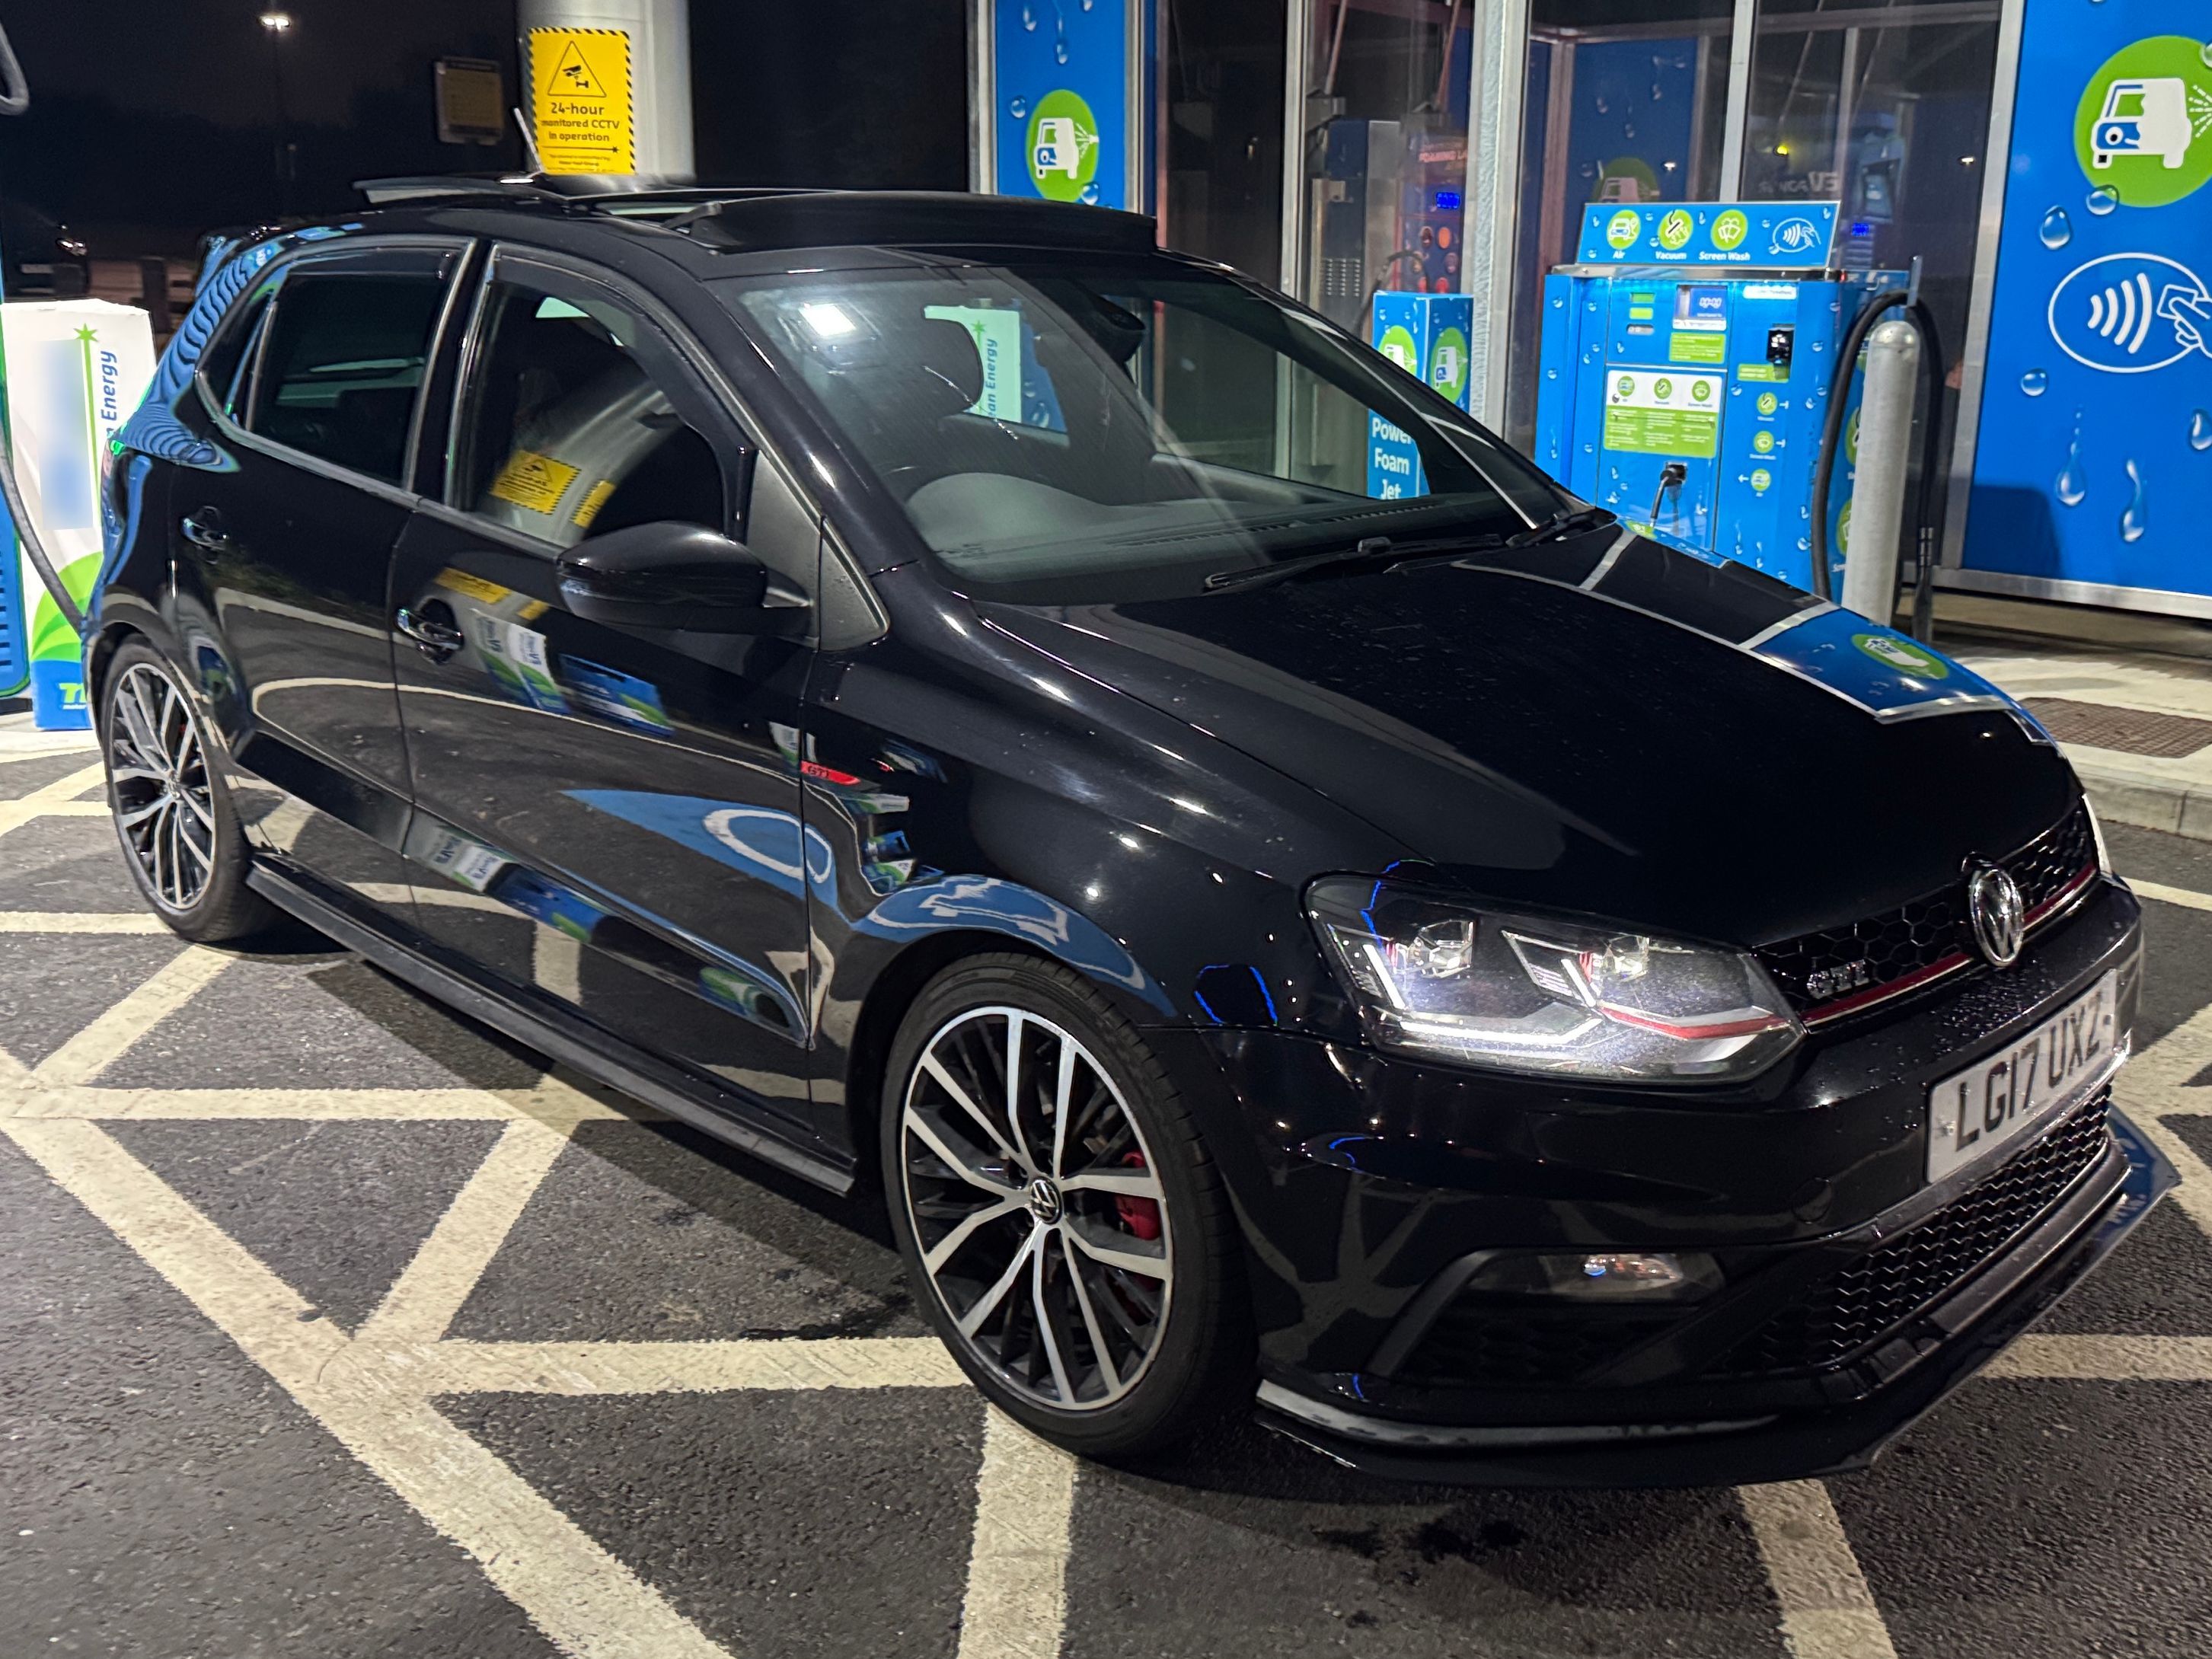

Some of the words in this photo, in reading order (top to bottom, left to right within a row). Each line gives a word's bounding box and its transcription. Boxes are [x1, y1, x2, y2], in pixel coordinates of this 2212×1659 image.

[551, 102, 605, 115] 24-hour
[541, 119, 589, 128] monitored
[591, 120, 620, 129] CCTV
[559, 133, 610, 142] operation
[1612, 250, 1626, 260] Air
[1655, 251, 1687, 260] Vacuum
[1699, 251, 1727, 260] Screen
[1728, 252, 1751, 261] Wash
[985, 338, 998, 389] Energy
[101, 350, 119, 421] Energy
[1372, 416, 1412, 445] Power
[1374, 447, 1410, 475] Foam
[1381, 478, 1402, 500] Jet
[808, 765, 829, 777] GTI
[1806, 959, 1869, 1000] GTI
[1955, 1037, 2041, 1153] LG17
